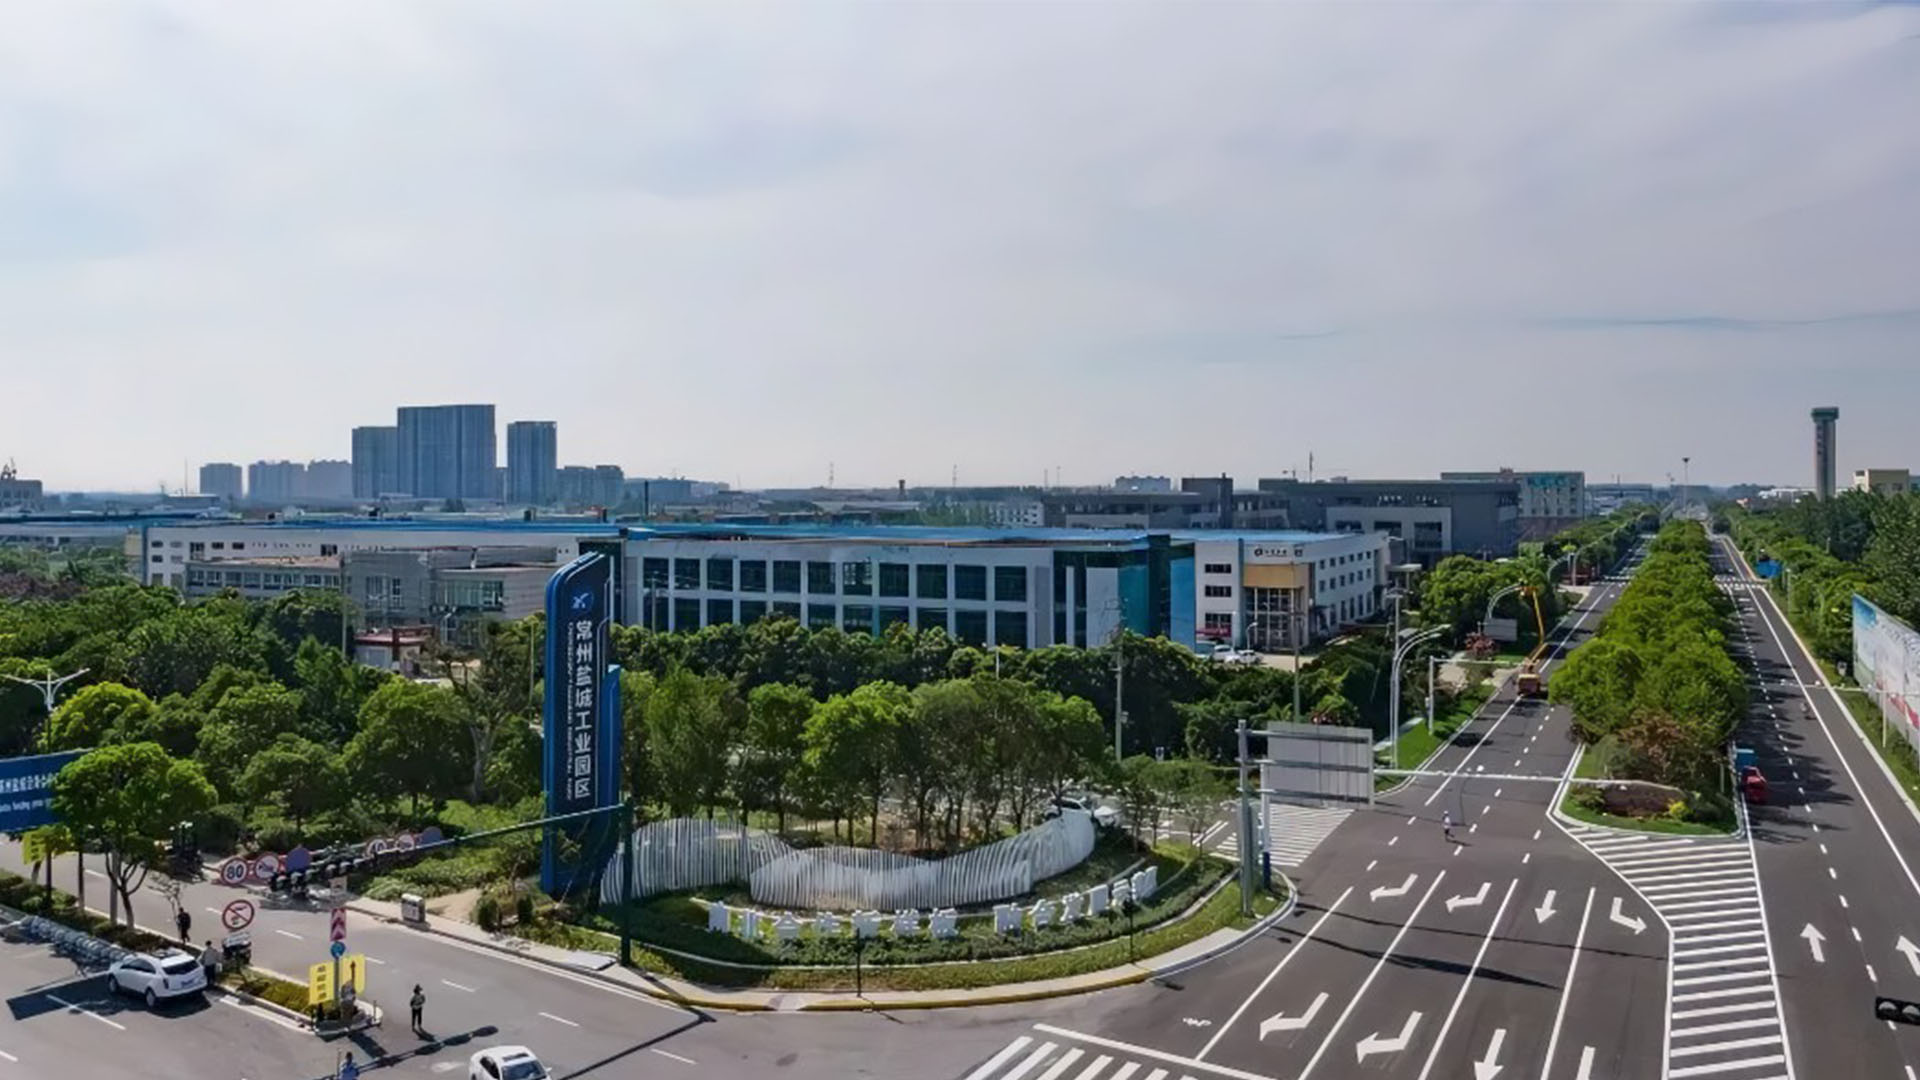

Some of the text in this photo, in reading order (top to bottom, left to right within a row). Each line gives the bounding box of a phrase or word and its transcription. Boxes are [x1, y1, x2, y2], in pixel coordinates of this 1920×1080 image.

[574, 620, 593, 799] 常州盐城工业园区
[227, 863, 243, 879] 80
